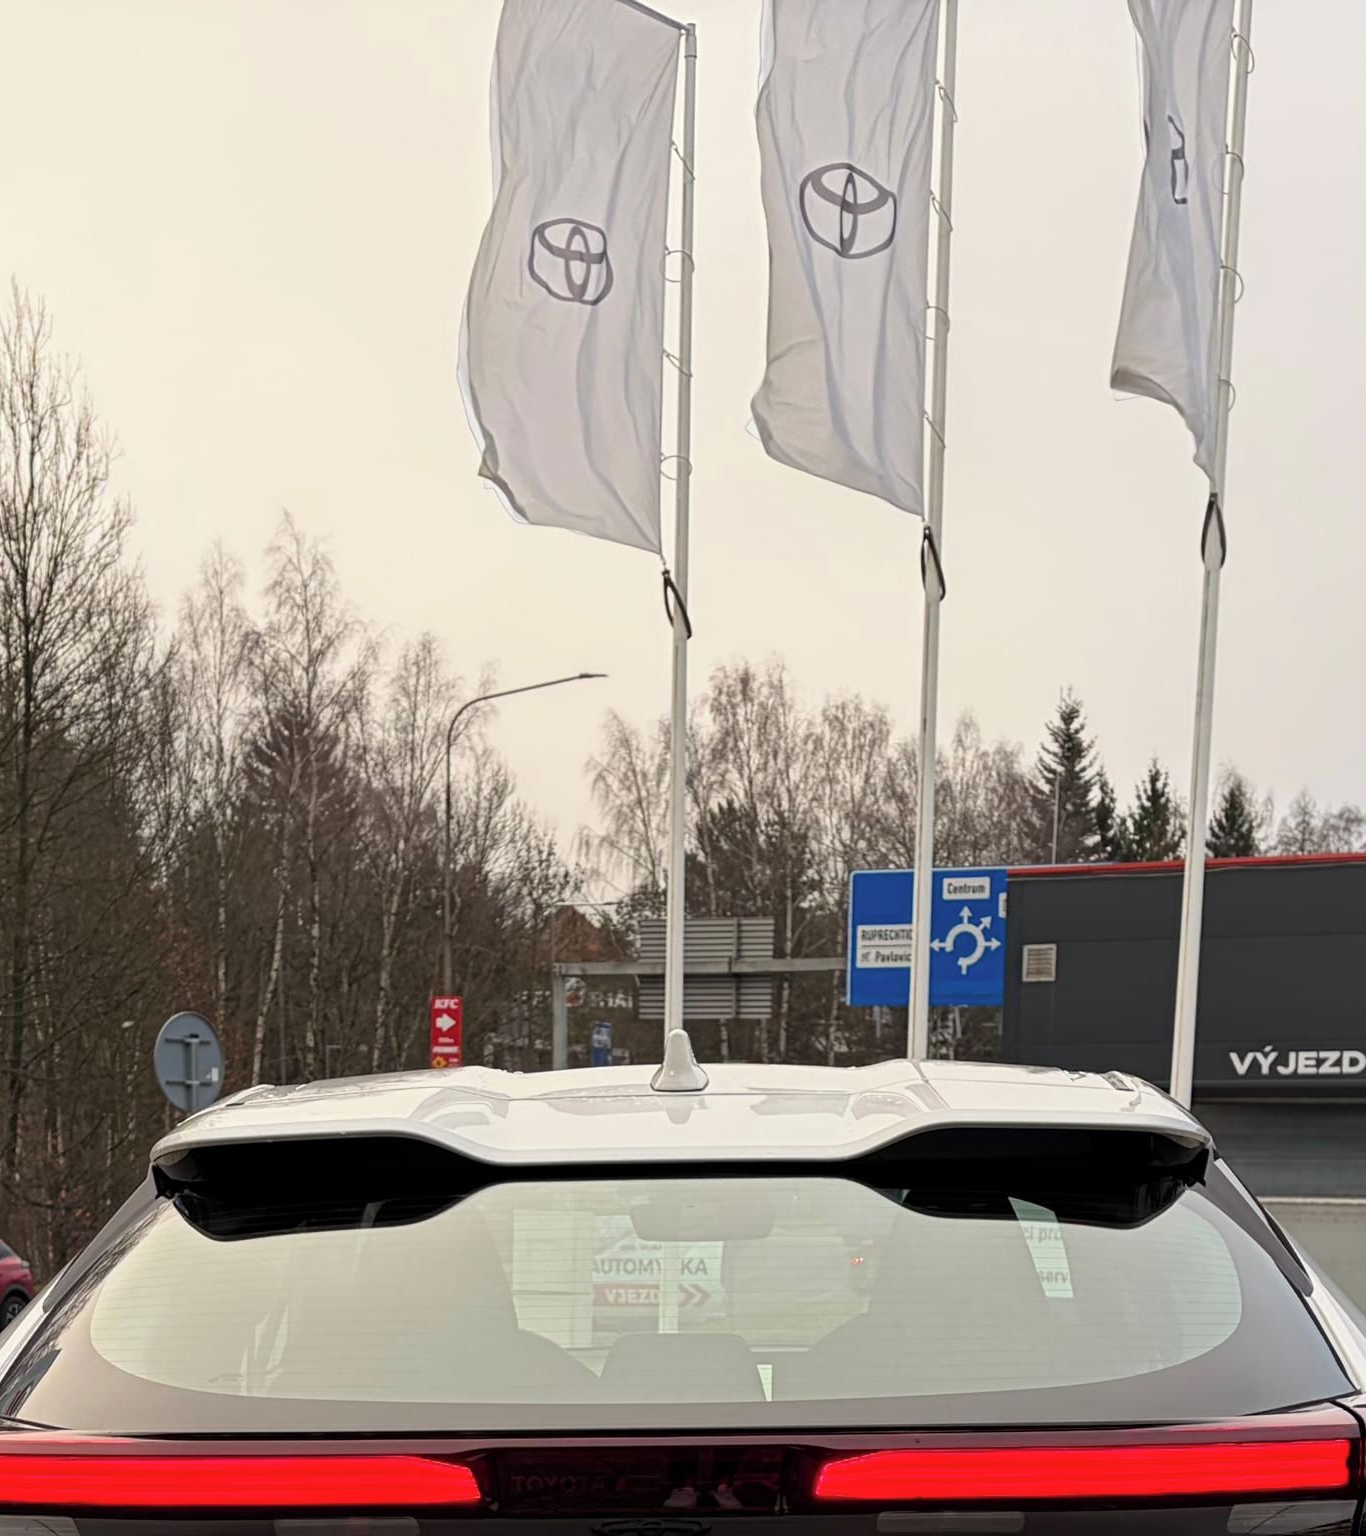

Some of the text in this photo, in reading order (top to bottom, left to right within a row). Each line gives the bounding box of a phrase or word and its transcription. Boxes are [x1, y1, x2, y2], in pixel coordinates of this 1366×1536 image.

[947, 882, 985, 895] Centrum
[861, 928, 913, 941] RUPRECHTIC
[874, 950, 912, 962] Pavlovic
[1229, 1045, 1366, 1075] VÝJEZD
[593, 1257, 708, 1276] AUTOMYKA
